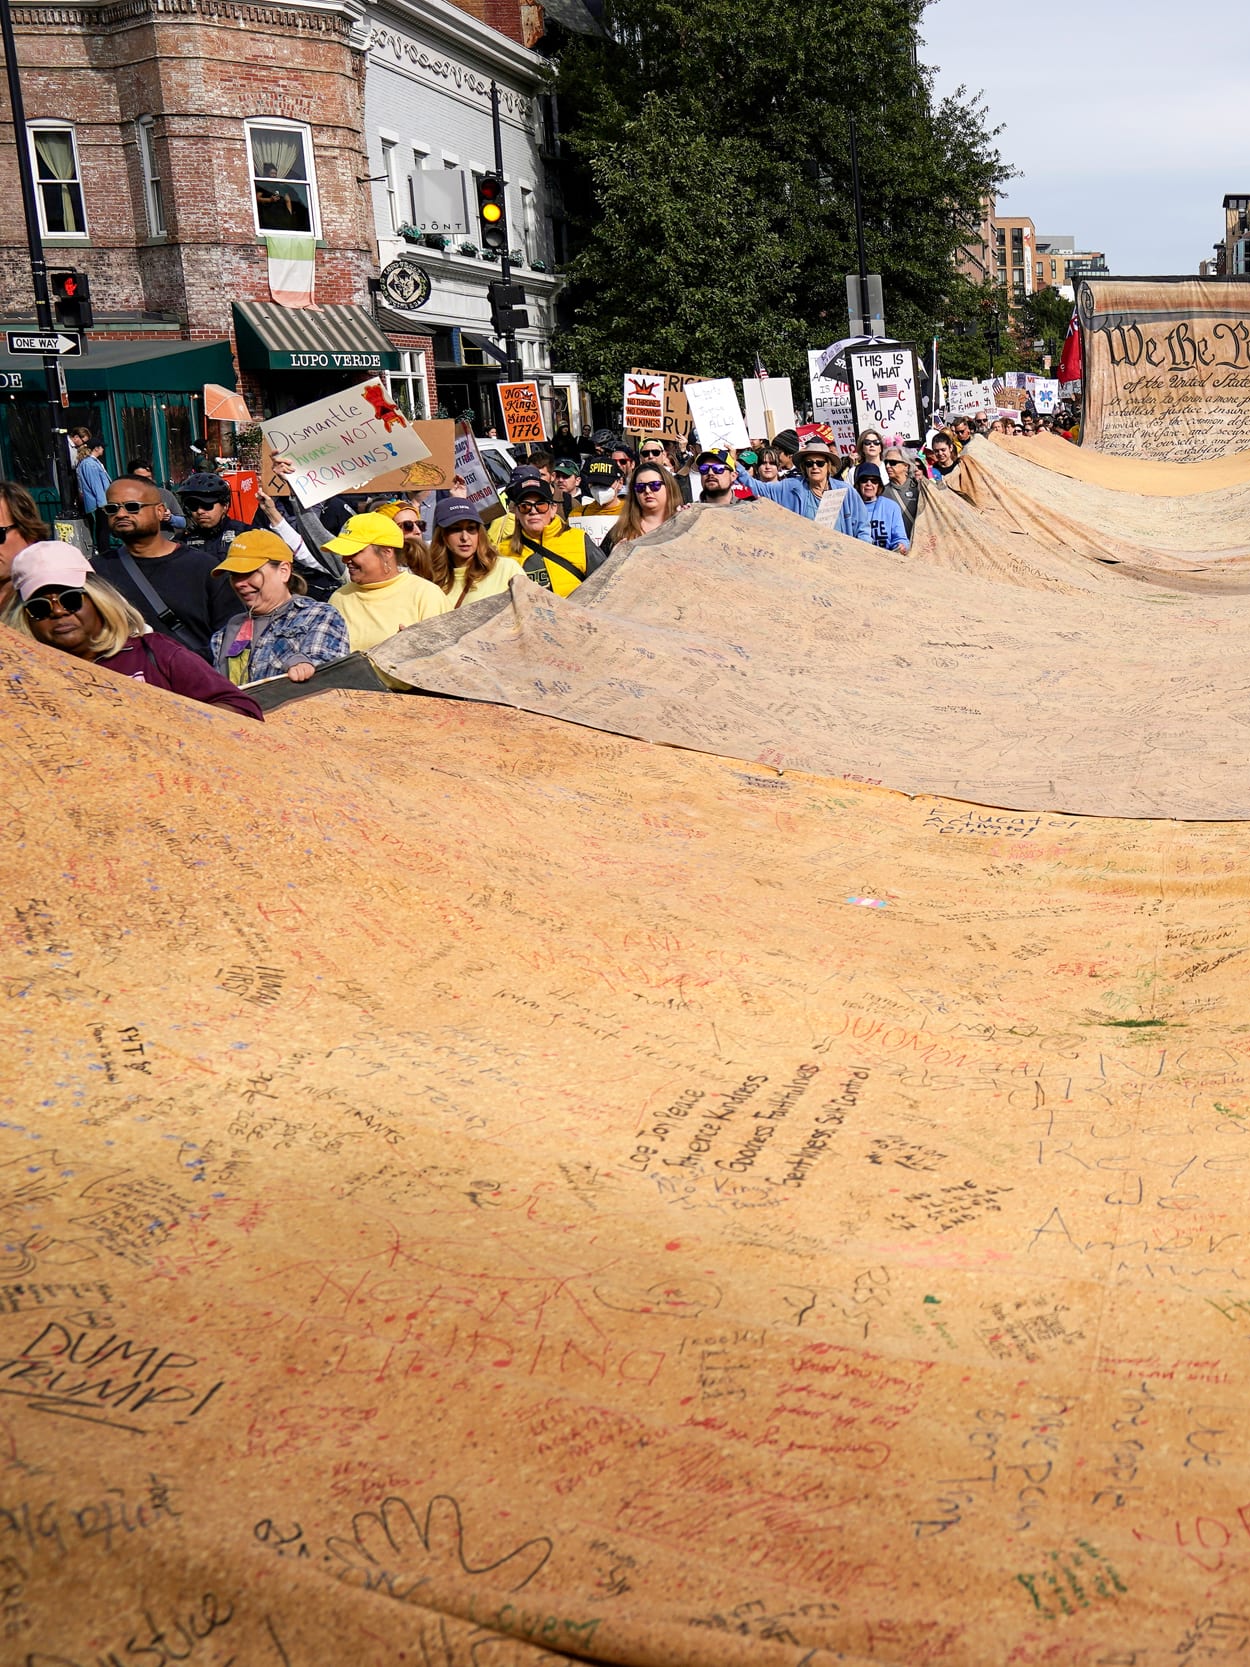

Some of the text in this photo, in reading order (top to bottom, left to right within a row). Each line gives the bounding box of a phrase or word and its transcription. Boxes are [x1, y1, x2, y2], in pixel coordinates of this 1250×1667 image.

[16, 338, 58, 349] ONE WAY
[1094, 316, 1166, 369] We
[1164, 322, 1216, 373] the
[290, 354, 381, 367] LUPO VERDE
[856, 353, 904, 368] THIS IS
[872, 366, 901, 379] WHAT
[1123, 376, 1144, 391] of
[1145, 375, 1167, 389] the
[1169, 373, 1211, 389] United
[504, 386, 527, 399] No
[504, 398, 538, 413] Kings
[626, 398, 662, 408] NO THRONES
[507, 411, 539, 425] Since
[626, 407, 662, 417] NO CROWNS
[267, 404, 363, 454] Dismantle
[626, 416, 661, 429] NO KINGS
[340, 418, 378, 447] NOT
[511, 423, 541, 438] 1776
[294, 443, 399, 496] PRONOUNS!
[589, 462, 613, 474] SPIRIT
[21, 1321, 198, 1383] DUMP
